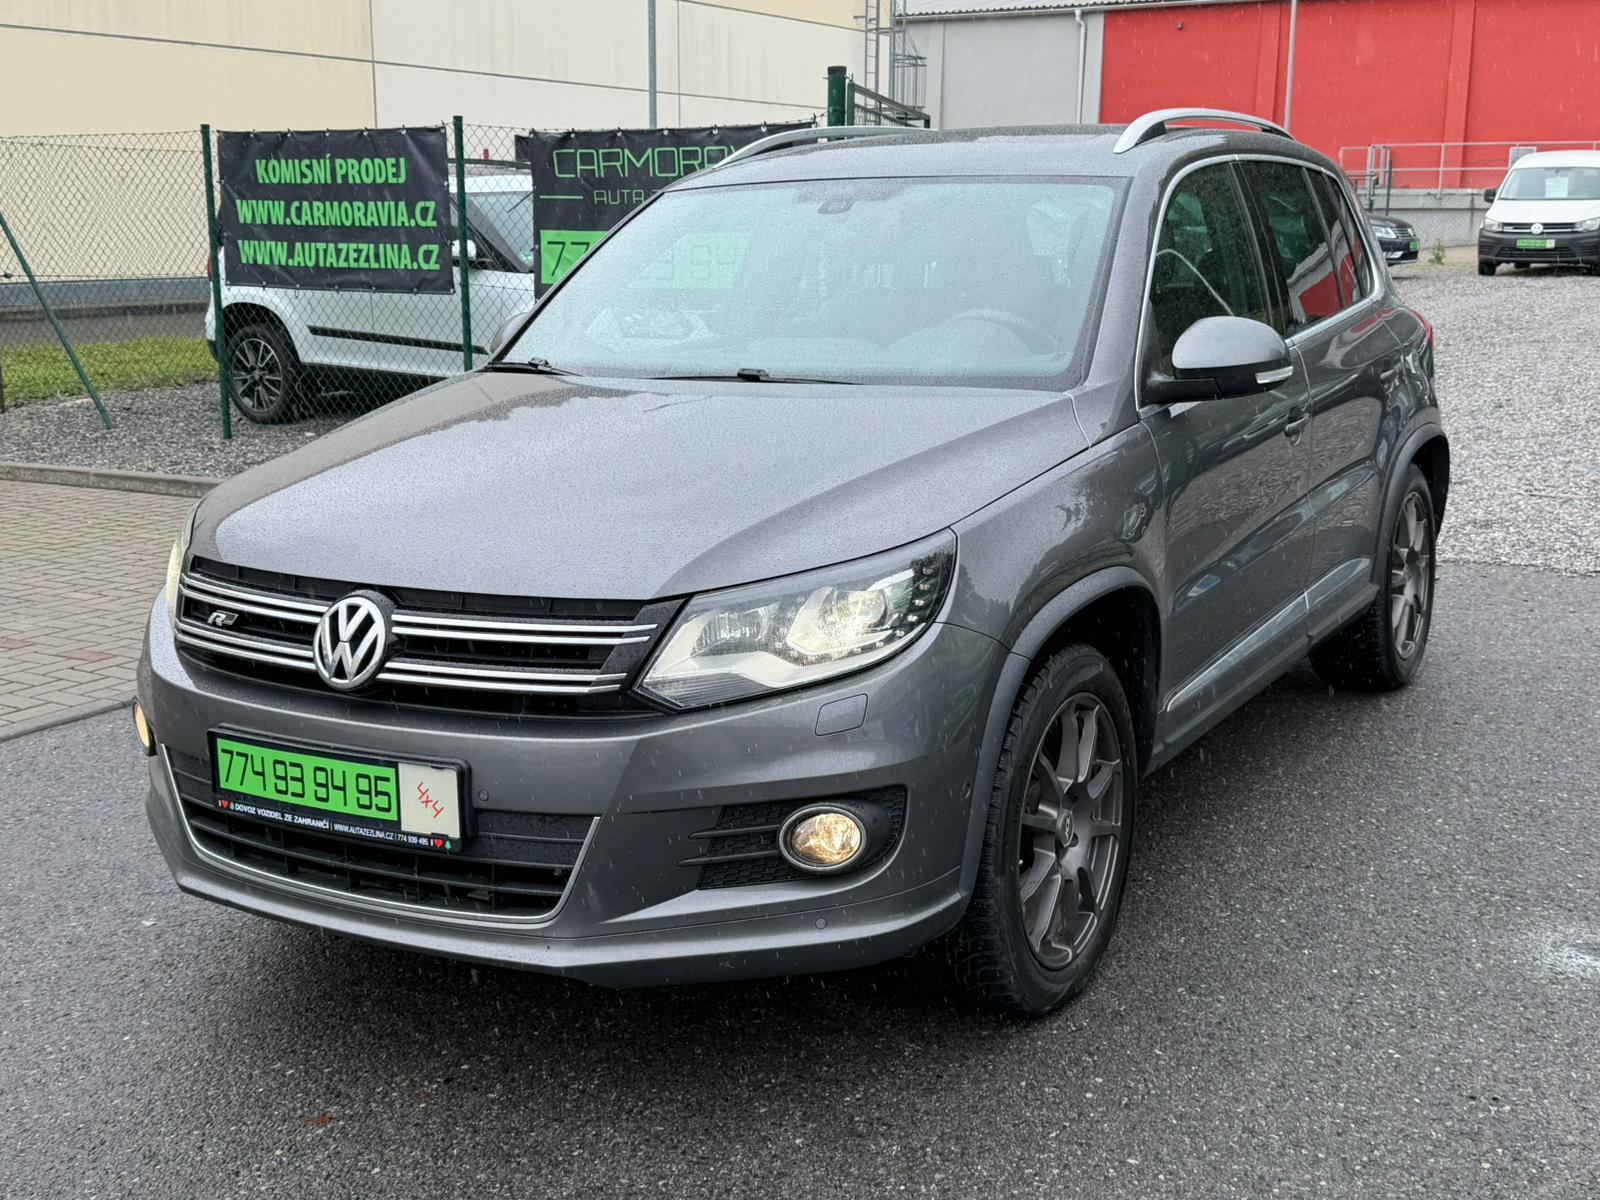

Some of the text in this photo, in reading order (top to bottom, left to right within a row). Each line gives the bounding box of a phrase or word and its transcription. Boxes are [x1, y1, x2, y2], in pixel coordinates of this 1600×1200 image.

[255, 154, 406, 184] KOMISNÍ PRODEJ
[553, 145, 735, 178] CARMORA
[594, 189, 644, 204] AUTA
[235, 199, 437, 227] WWW.CARMORAVIA.CZ
[237, 240, 440, 270] WWW.AUTAZEZLINA.CZ
[221, 748, 391, 813] 774 93 94 95
[234, 803, 256, 814] DOVOZ
[257, 808, 283, 820] VOZIDEL
[284, 813, 293, 822] ZE
[293, 815, 329, 829] ZAHRANIČÍ
[333, 823, 393, 840] WWW.AUTAZEZLINA.CZ
